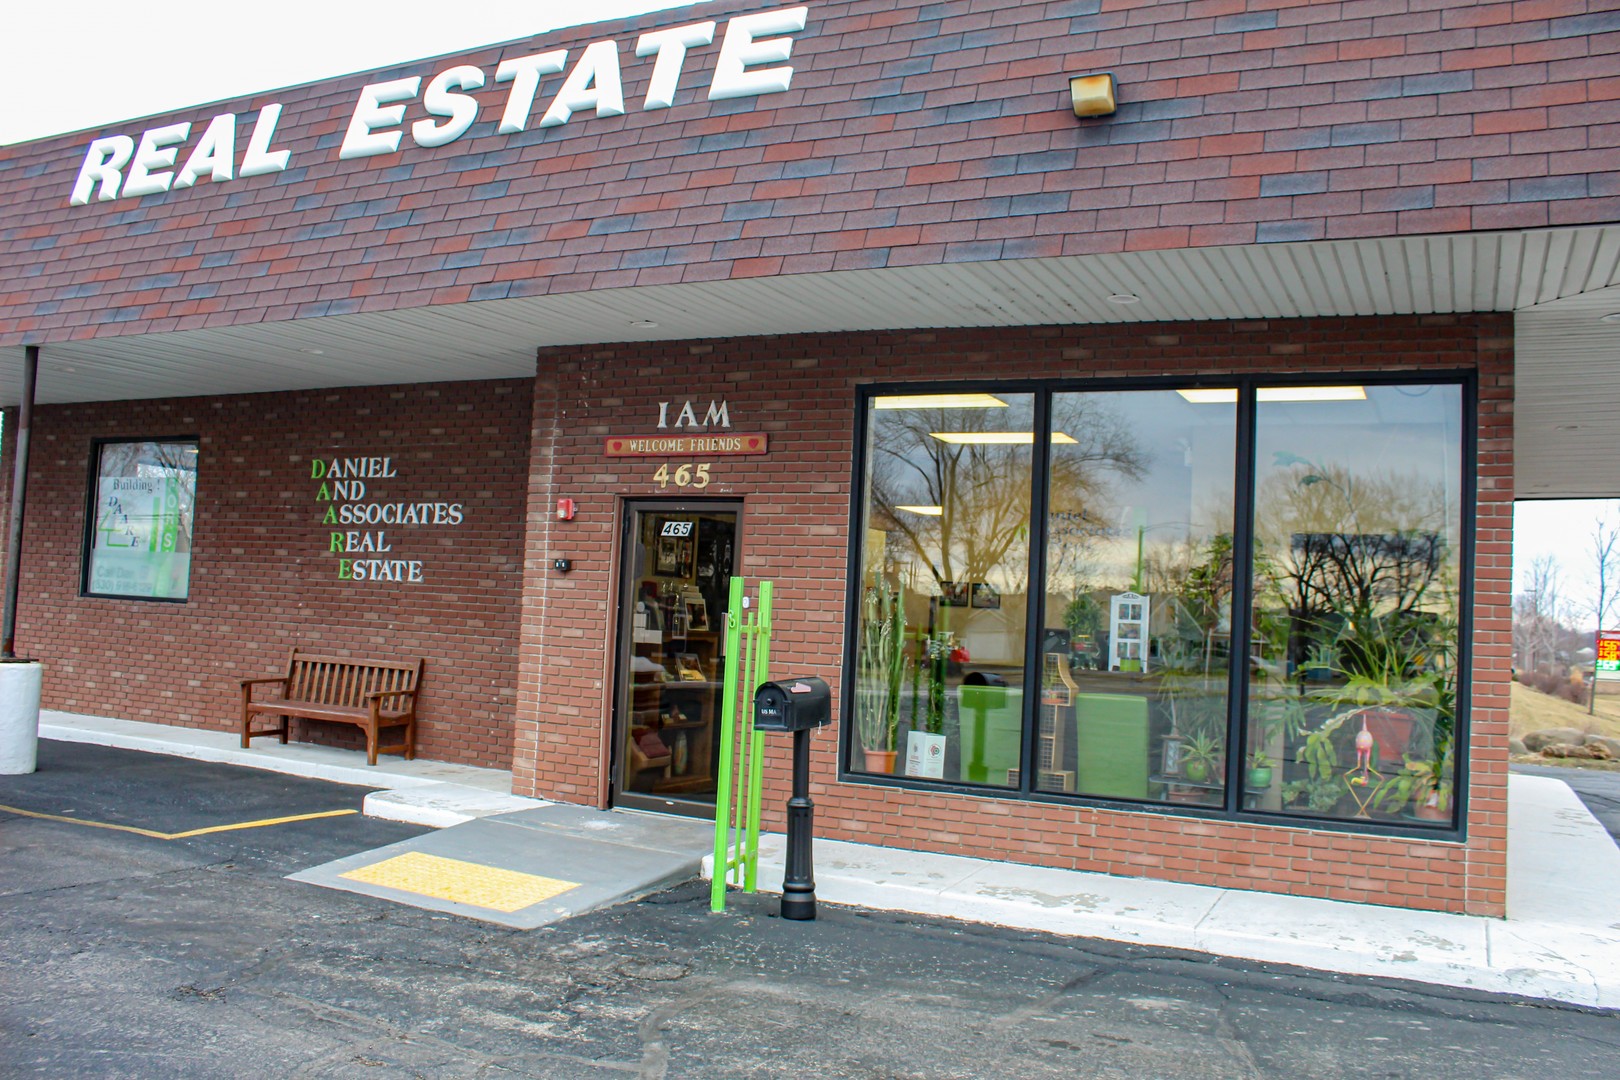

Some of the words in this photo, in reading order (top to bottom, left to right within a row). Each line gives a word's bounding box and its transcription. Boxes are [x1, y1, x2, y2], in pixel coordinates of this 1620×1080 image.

[70, 103, 291, 206] REAL
[339, 7, 809, 160] ESTATE
[657, 402, 669, 428] I
[674, 400, 730, 427] AM
[629, 439, 684, 452] WELCOME
[690, 438, 741, 451] FRIENDS
[311, 457, 397, 479] DANIEL
[653, 463, 711, 488] 465
[113, 478, 153, 493] Building
[316, 480, 366, 501] AND
[322, 502, 464, 525] ASSOCIATES
[663, 523, 691, 535] 465
[330, 531, 391, 553] REAL
[338, 558, 424, 583] ESTATE
